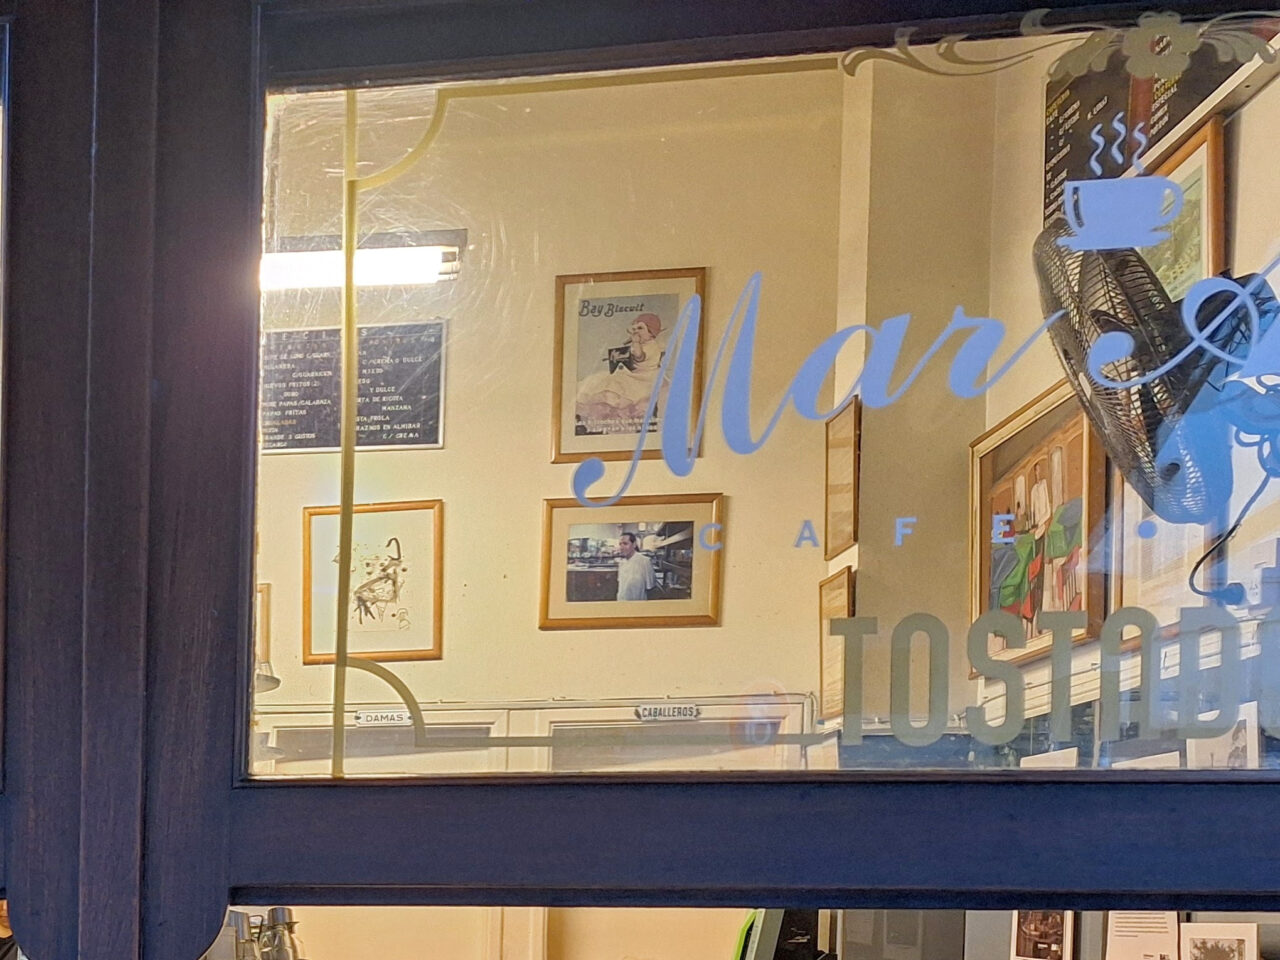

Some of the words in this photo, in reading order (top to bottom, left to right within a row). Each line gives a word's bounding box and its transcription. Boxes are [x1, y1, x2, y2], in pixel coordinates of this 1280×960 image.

[579, 300, 604, 318] Bay
[604, 303, 645, 318] Biscuit
[571, 270, 1068, 508] Mar
[699, 513, 1015, 550] CAFE
[830, 606, 1280, 747] TOSTAD
[365, 713, 404, 722] DAMAS
[641, 706, 694, 718] CABALLEROS
